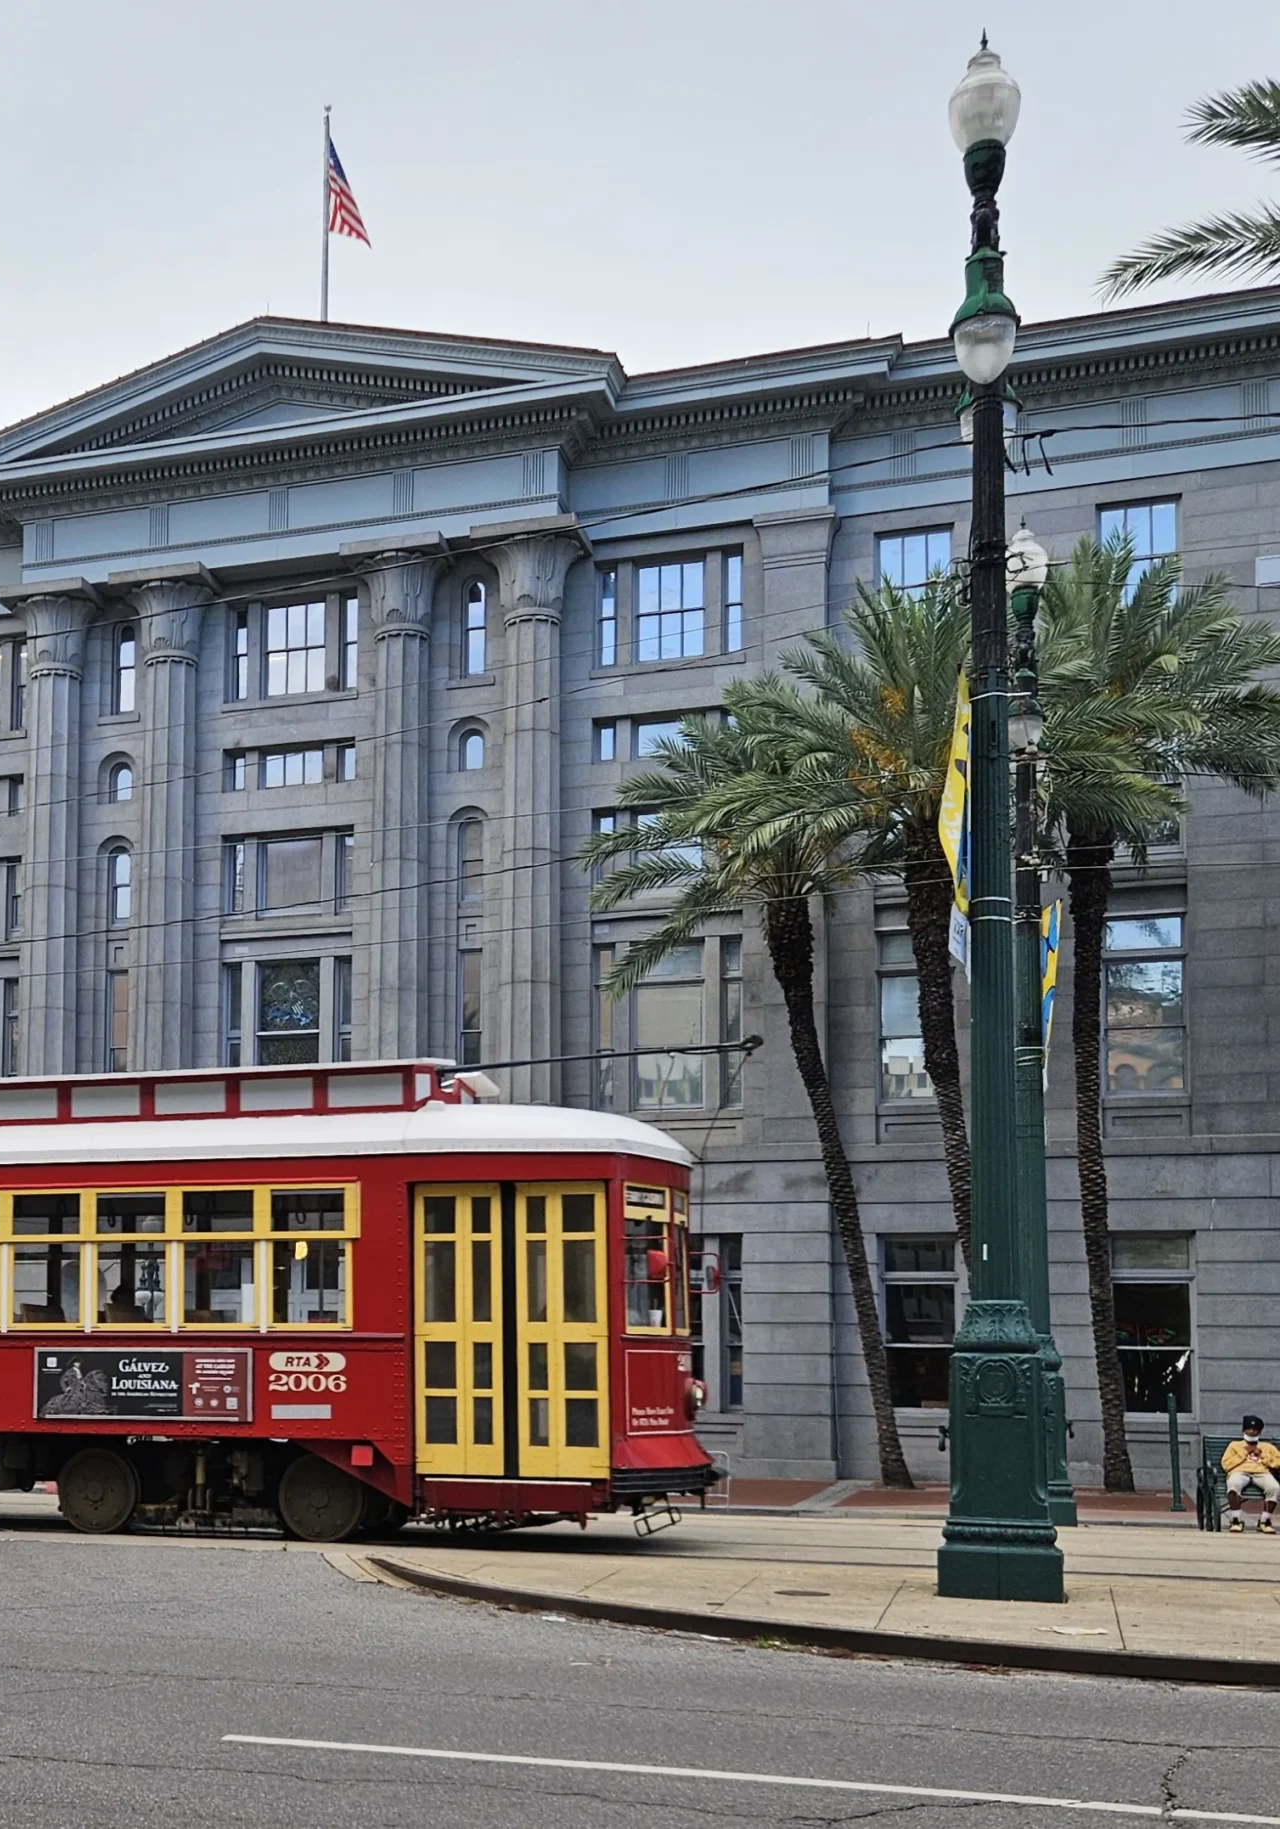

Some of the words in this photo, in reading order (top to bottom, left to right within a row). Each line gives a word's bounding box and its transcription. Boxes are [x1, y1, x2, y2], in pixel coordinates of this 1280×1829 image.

[118, 1357, 170, 1373] GÁLVEZ
[284, 1356, 312, 1367] RTA
[111, 1376, 179, 1390] LOUISIANA
[268, 1373, 347, 1393] 2006
